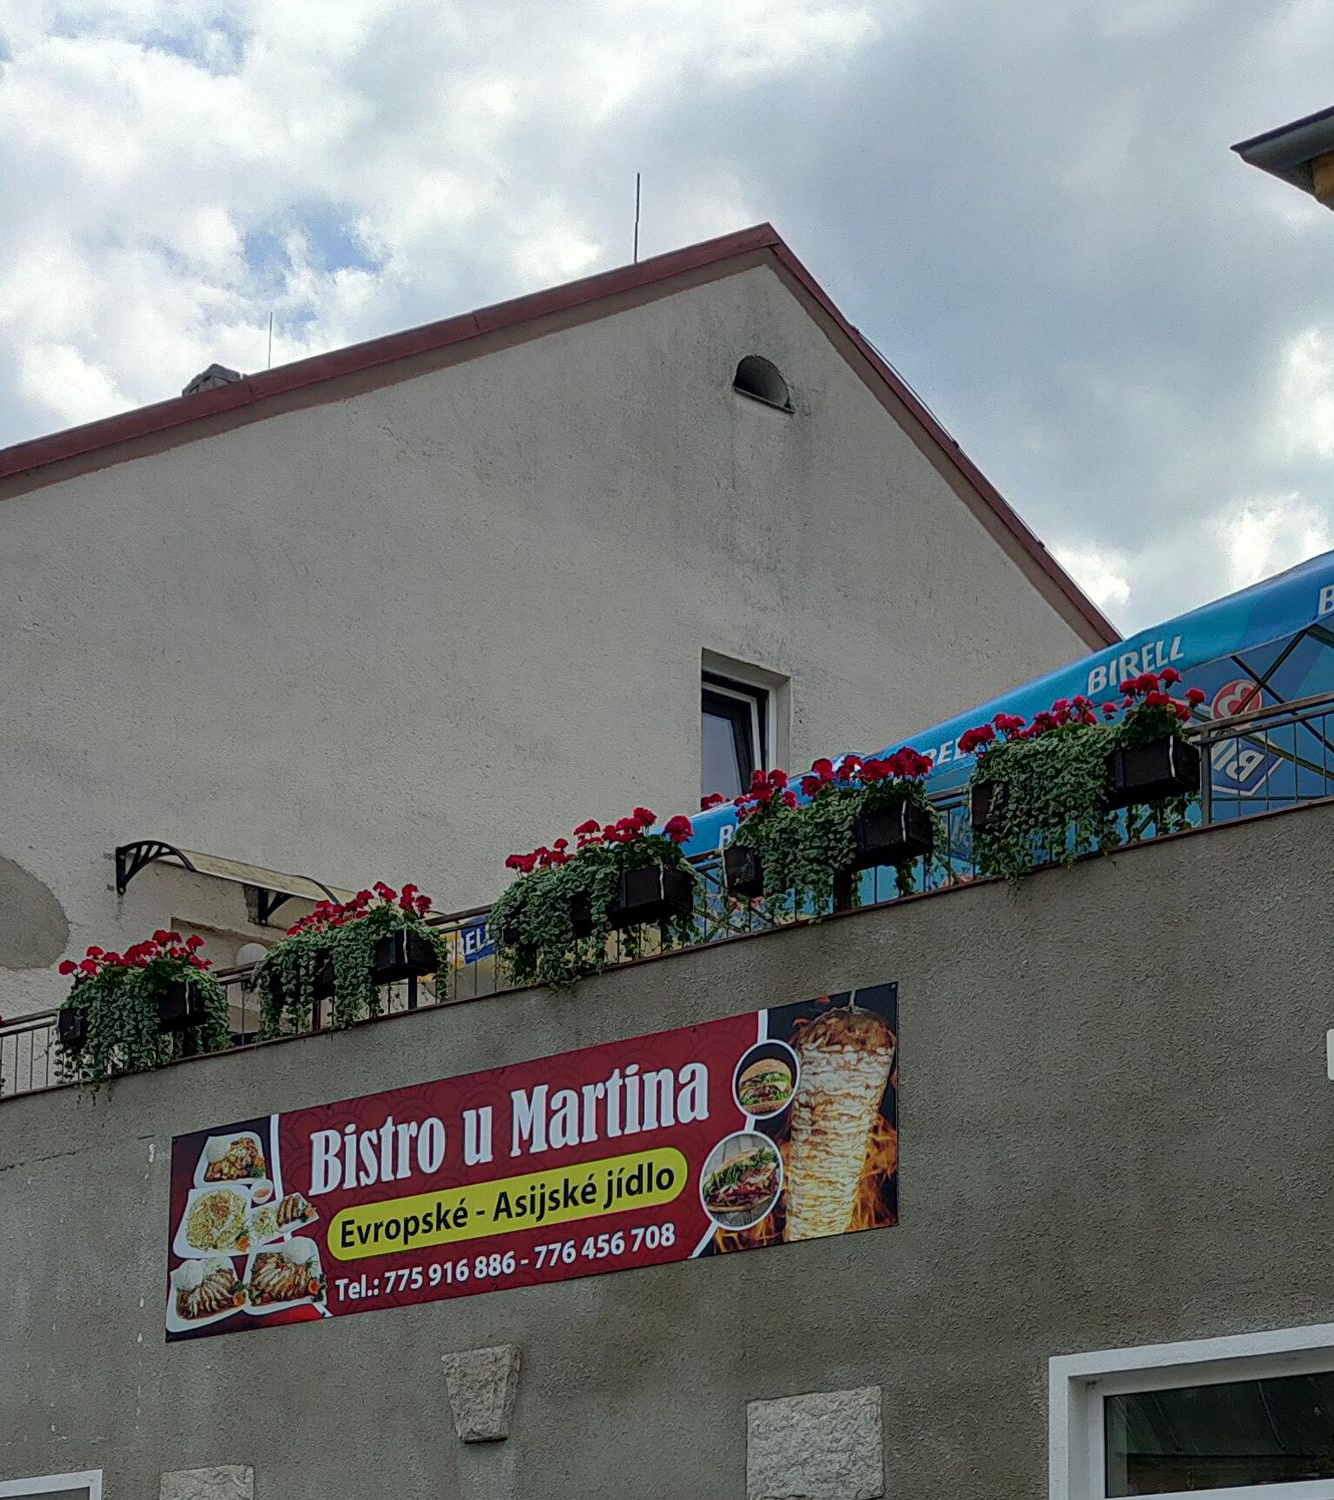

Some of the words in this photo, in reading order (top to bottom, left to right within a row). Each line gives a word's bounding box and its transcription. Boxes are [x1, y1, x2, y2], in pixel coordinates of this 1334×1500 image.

[1087, 635, 1184, 697] BIRELL
[308, 1116, 446, 1196] Bistro
[462, 1105, 493, 1166] u
[510, 1063, 710, 1157] Martina
[341, 1197, 468, 1248] Evropské
[492, 1174, 597, 1223] Asijské
[603, 1161, 676, 1210] jídlo
[335, 1275, 379, 1302] Tel.:
[384, 1266, 423, 1294] 775
[428, 1258, 469, 1286] 916
[474, 1250, 516, 1279] 886
[534, 1240, 577, 1269] 776
[581, 1231, 625, 1260] 456
[631, 1222, 676, 1252] 708
